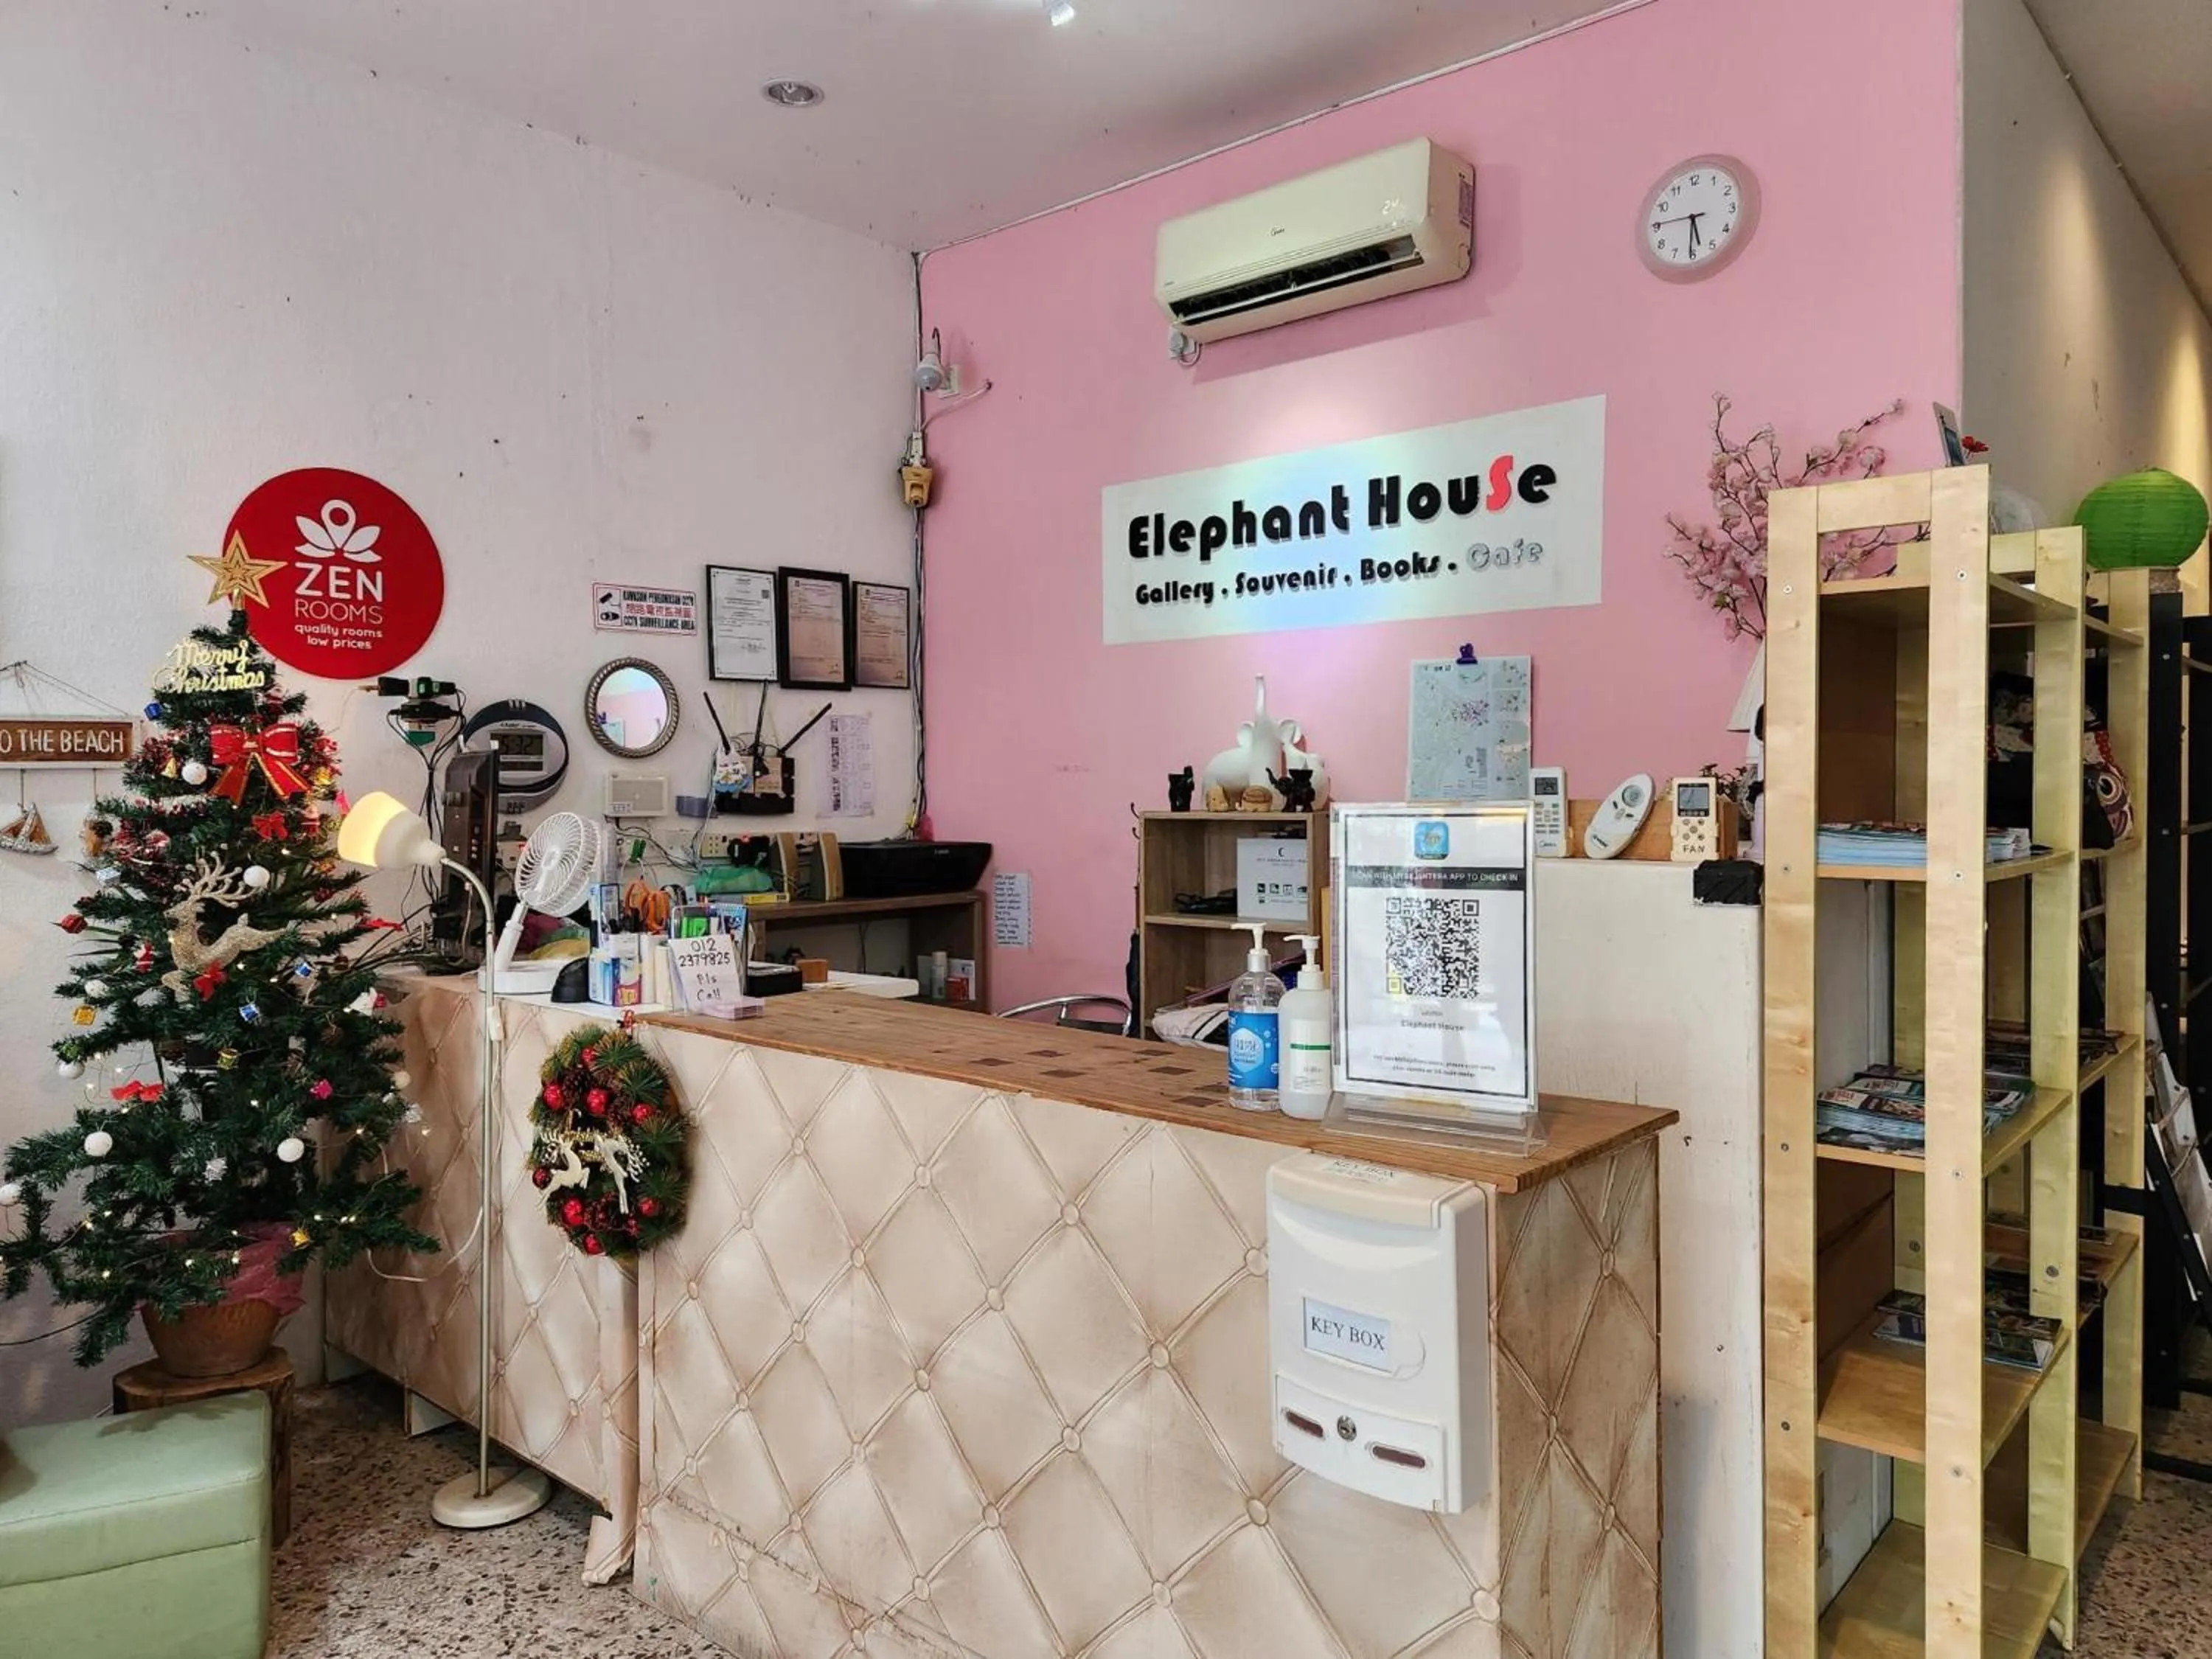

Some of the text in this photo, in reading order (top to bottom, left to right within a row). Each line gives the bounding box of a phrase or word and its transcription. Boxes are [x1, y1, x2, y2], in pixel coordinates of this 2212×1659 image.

[1689, 175, 1700, 186] 12
[1711, 175, 1717, 186] 1
[1671, 186, 1681, 197] 11
[1723, 185, 1733, 196] 2
[1658, 201, 1669, 213] 10
[1728, 202, 1736, 214] 3
[1722, 223, 1731, 234] 4
[1658, 238, 1666, 249] 8
[1672, 248, 1679, 259] 7
[1128, 484, 1350, 562] Elephant
[1135, 538, 1543, 606] Gallery Souvenir Books Cafe
[295, 561, 383, 602] ZEN
[295, 599, 383, 625] ROOMS
[295, 625, 383, 639] quality rooms
[307, 635, 372, 650] low prices
[18, 728, 55, 752] THE
[60, 728, 124, 754] BEACH
[1683, 845, 1705, 853] FAN
[691, 937, 717, 953] 012
[678, 952, 731, 967] 2379825
[1311, 1315, 1385, 1352] KEY BOX
